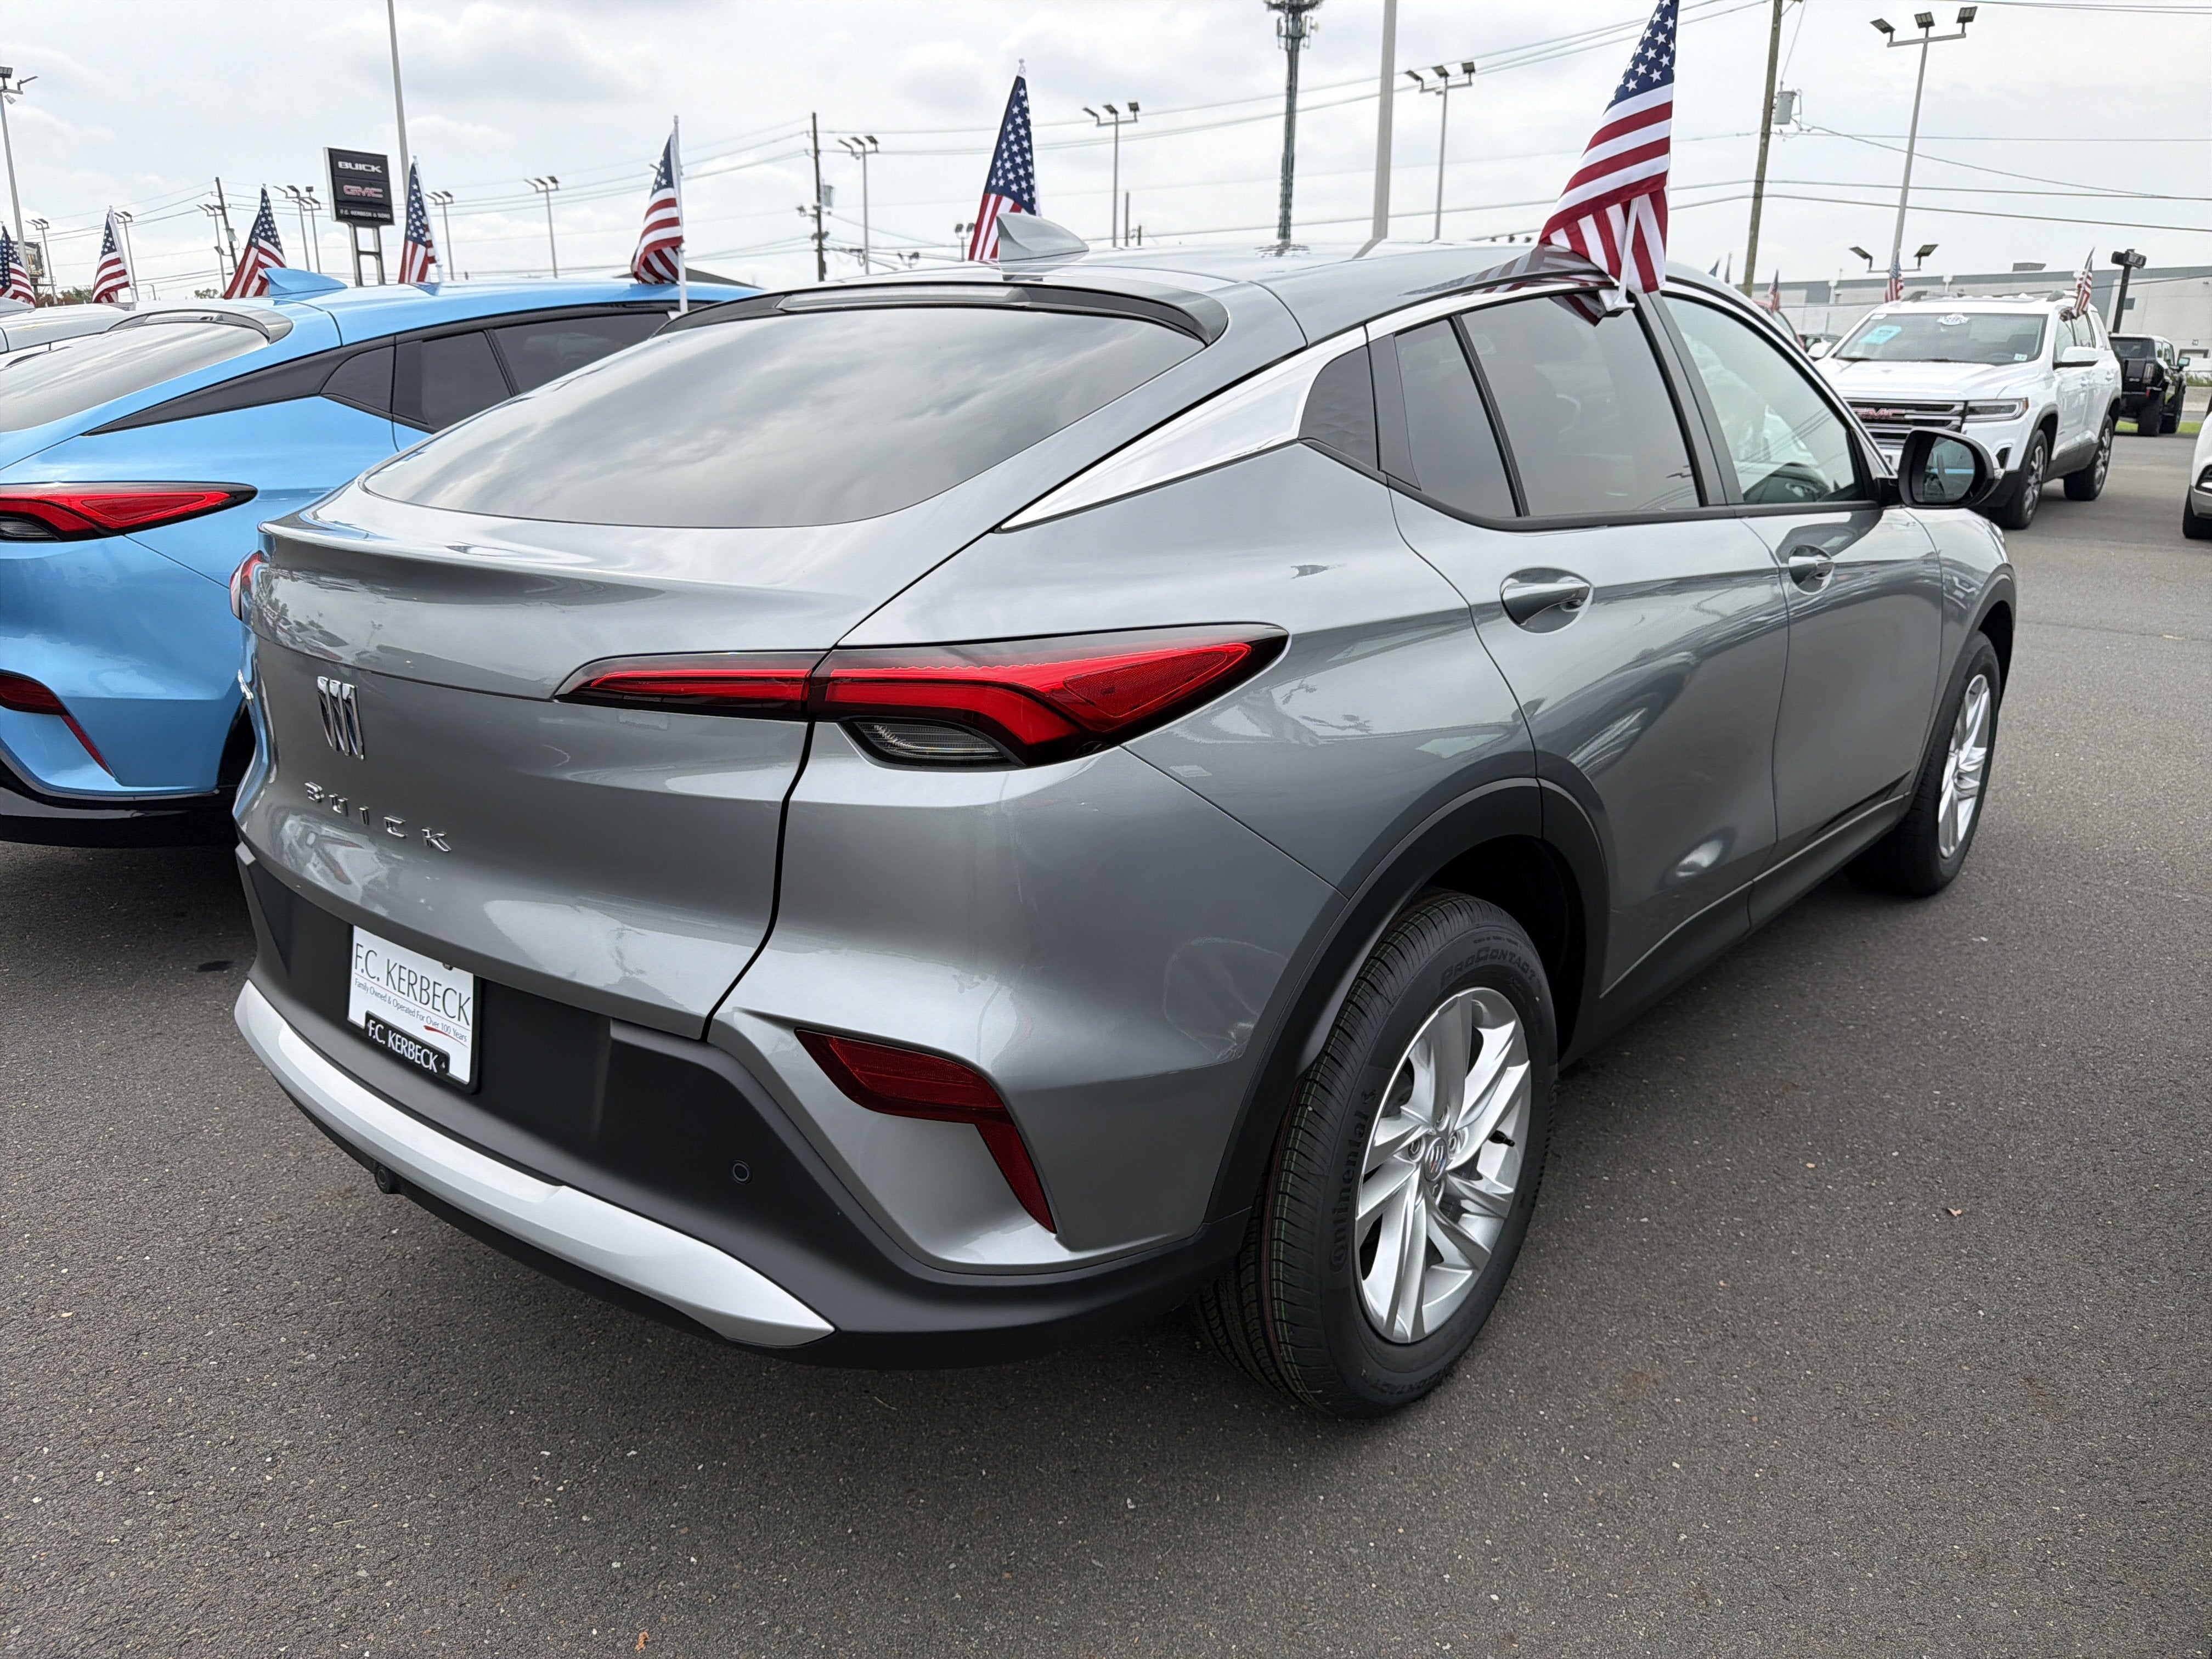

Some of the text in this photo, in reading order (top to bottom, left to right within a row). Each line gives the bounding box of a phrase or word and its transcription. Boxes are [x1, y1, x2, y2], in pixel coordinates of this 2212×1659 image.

[338, 161, 382, 173] BUICK
[343, 185, 383, 198] GMC
[304, 781, 452, 852] BUICK
[354, 943, 471, 1026] F.C. KERBECK
[354, 978, 467, 1042] Family Owned & Operated For Over 100 Years
[367, 1019, 438, 1073] F.C. KERBECK
